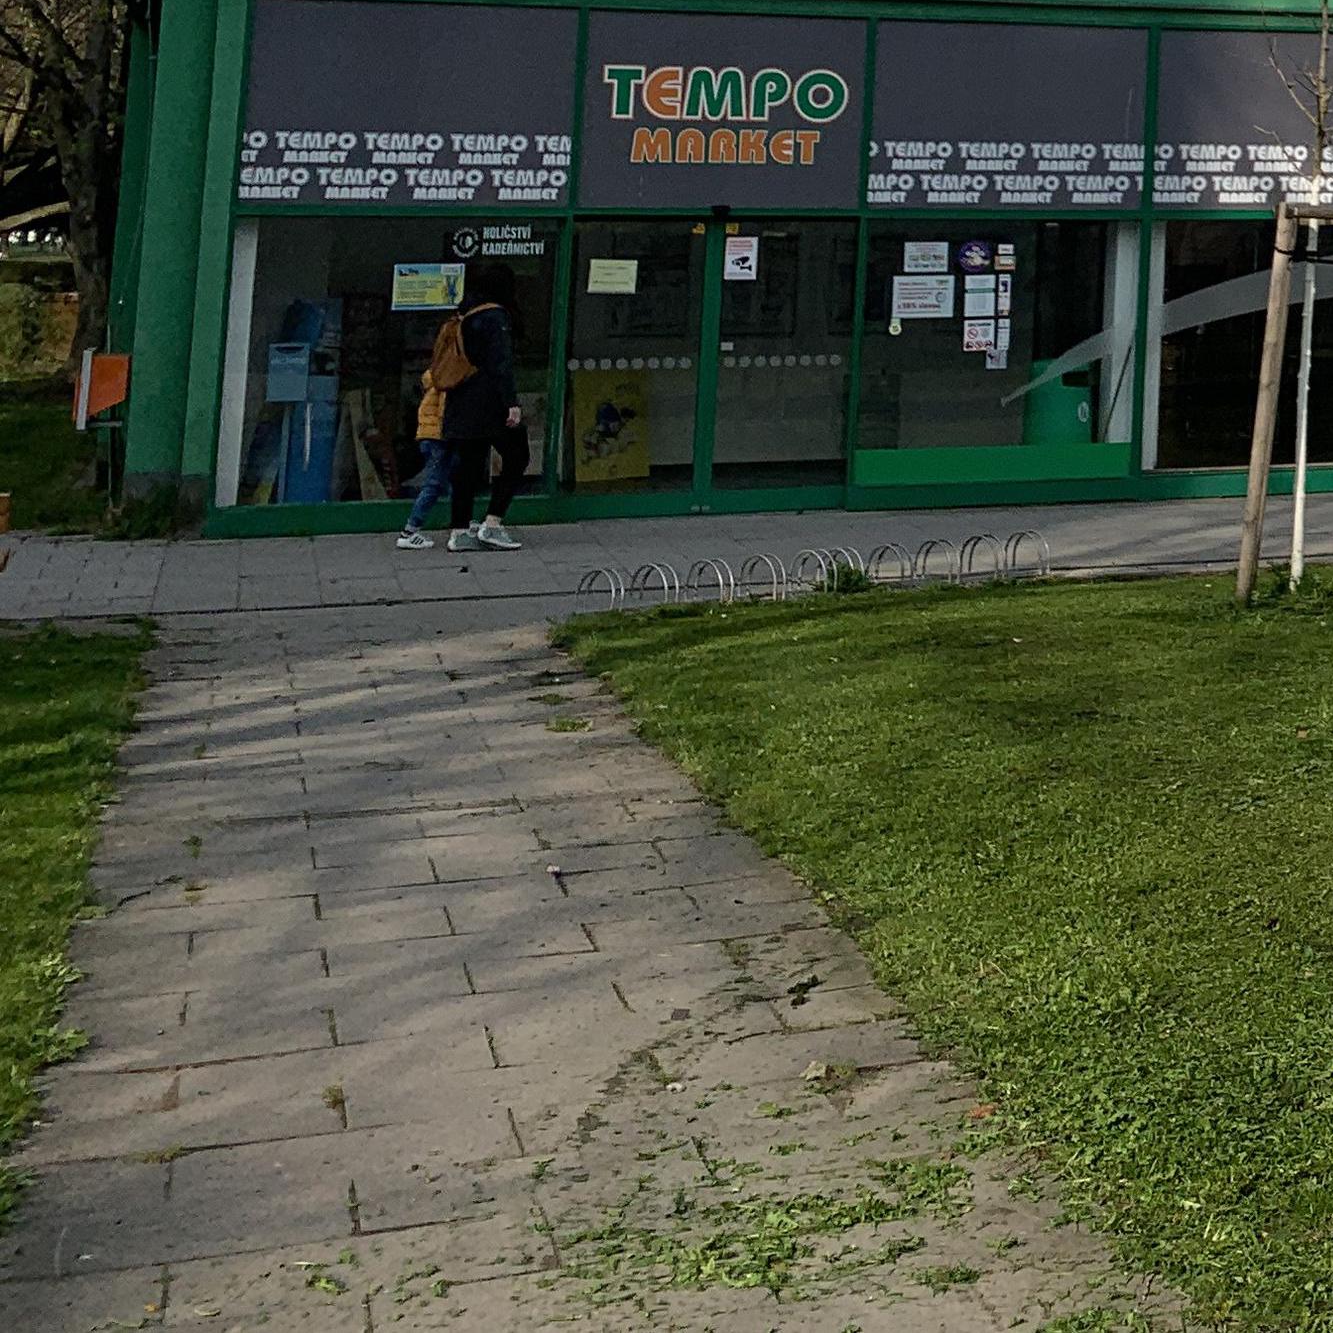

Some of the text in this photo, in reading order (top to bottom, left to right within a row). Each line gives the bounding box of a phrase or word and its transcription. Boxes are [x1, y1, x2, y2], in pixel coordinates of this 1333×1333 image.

[604, 64, 849, 122] TEMPO
[275, 131, 357, 150] TEMPO
[364, 132, 444, 151] TEMPO
[450, 133, 528, 152] TEMPO
[630, 127, 820, 164] MARKET
[884, 141, 953, 157] TEMPO
[958, 142, 1026, 158] TEMPO
[1031, 143, 1097, 159] TEMPO
[1179, 144, 1242, 160] TEMPO
[239, 167, 567, 187] EMPO TEMPO TEMPO TEMPO
[920, 174, 988, 190] TEMPO
[993, 174, 1060, 191] TEMPO
[1065, 175, 1130, 191] TEMPO
[1153, 176, 1207, 191] EMPO
[1212, 176, 1275, 192] TEMPO
